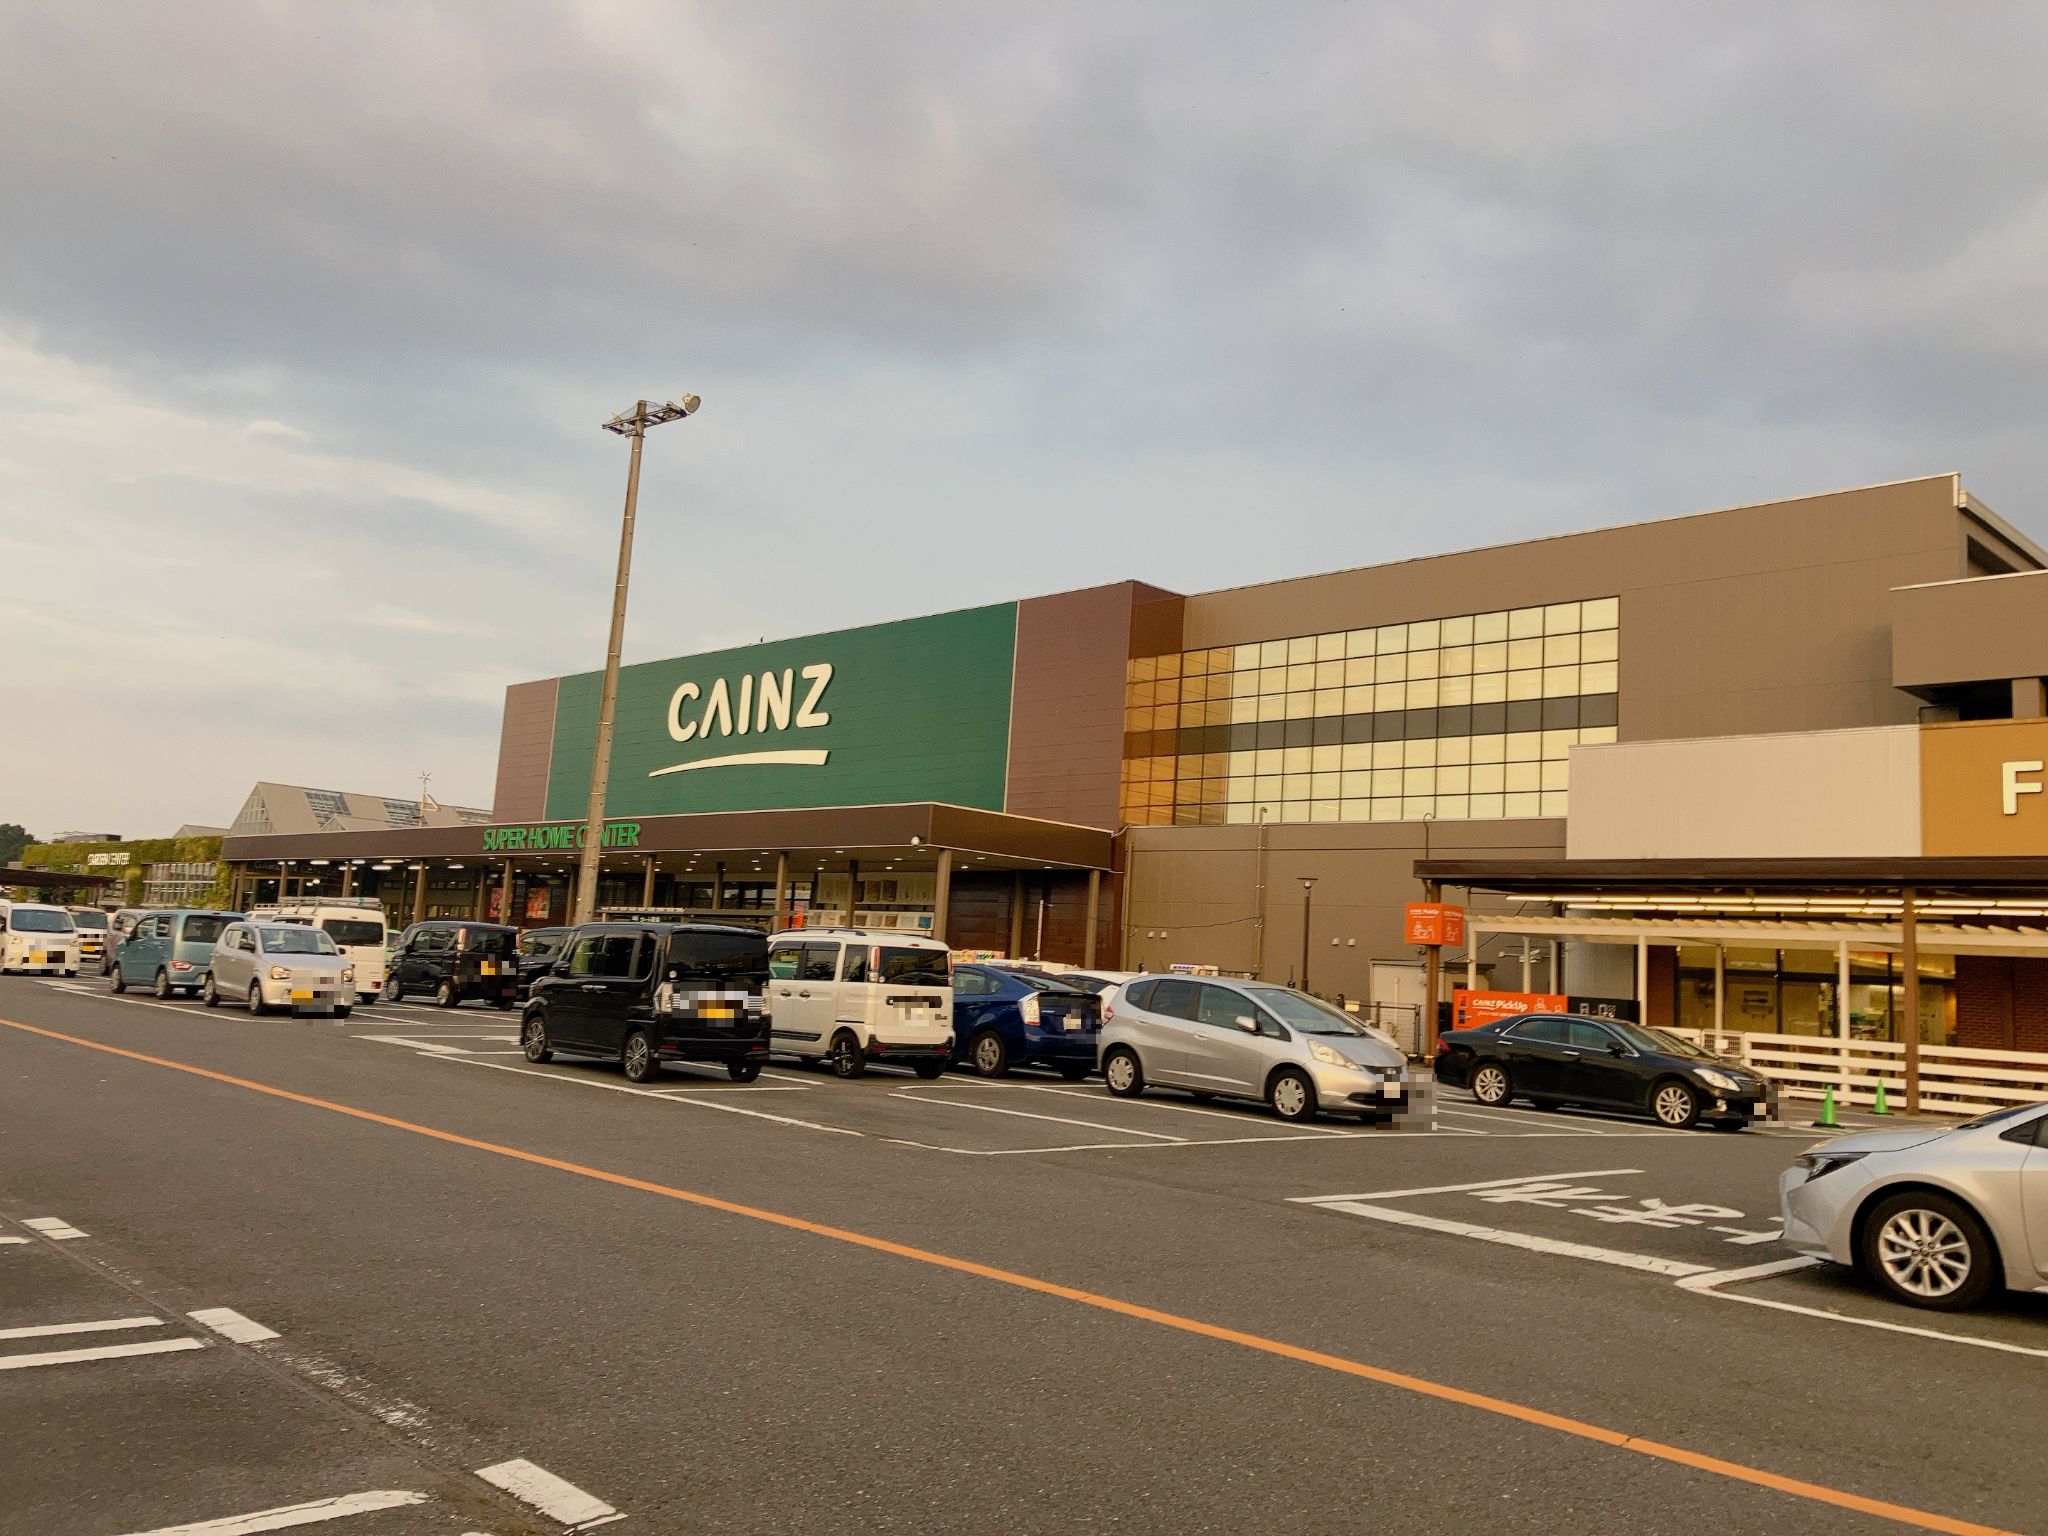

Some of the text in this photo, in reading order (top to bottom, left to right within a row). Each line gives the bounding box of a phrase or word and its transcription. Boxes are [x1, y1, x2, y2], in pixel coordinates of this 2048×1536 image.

[668, 663, 833, 742] CAINZ
[2002, 760, 2044, 815] F
[482, 823, 641, 850] SUPER HOME CNTER
